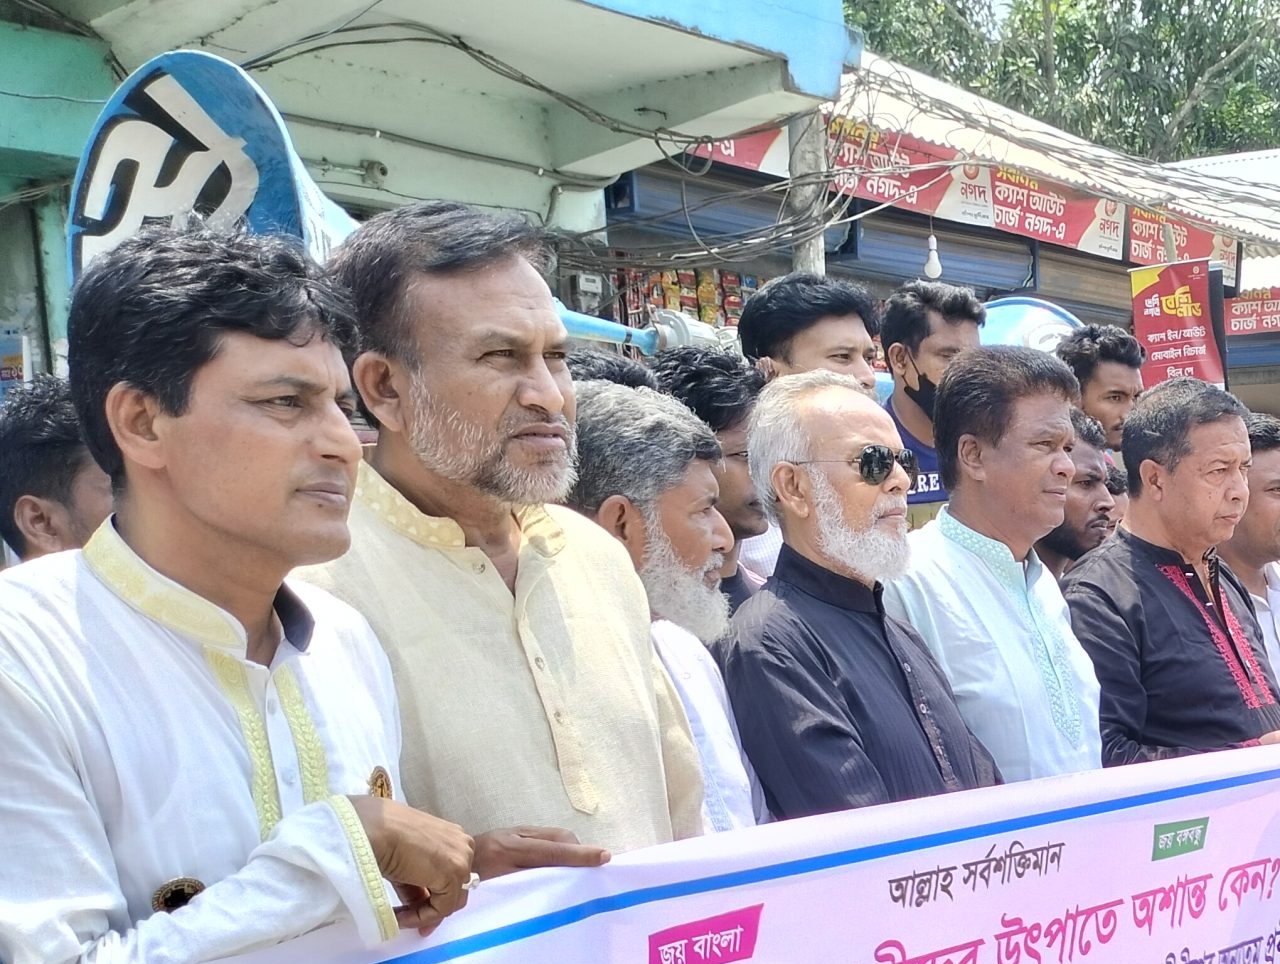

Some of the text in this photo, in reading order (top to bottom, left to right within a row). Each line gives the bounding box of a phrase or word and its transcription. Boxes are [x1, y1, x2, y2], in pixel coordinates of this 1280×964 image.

[960, 181, 988, 201] নগদ
[995, 181, 1065, 217] ক্যাশ আউট
[1024, 212, 1065, 240] নগদ-এ
[1100, 219, 1119, 239] নগদ
[1132, 218, 1158, 240] ক্যাশ
[1232, 300, 1261, 315] ক্যাশ
[1158, 832, 1174, 850] জয়
[889, 841, 1065, 907] আল্লাহ সর্বশক্তিমান
[1132, 874, 1213, 935] অশান্ত
[1219, 857, 1280, 911] কেন?
[693, 924, 744, 957] বাংলা
